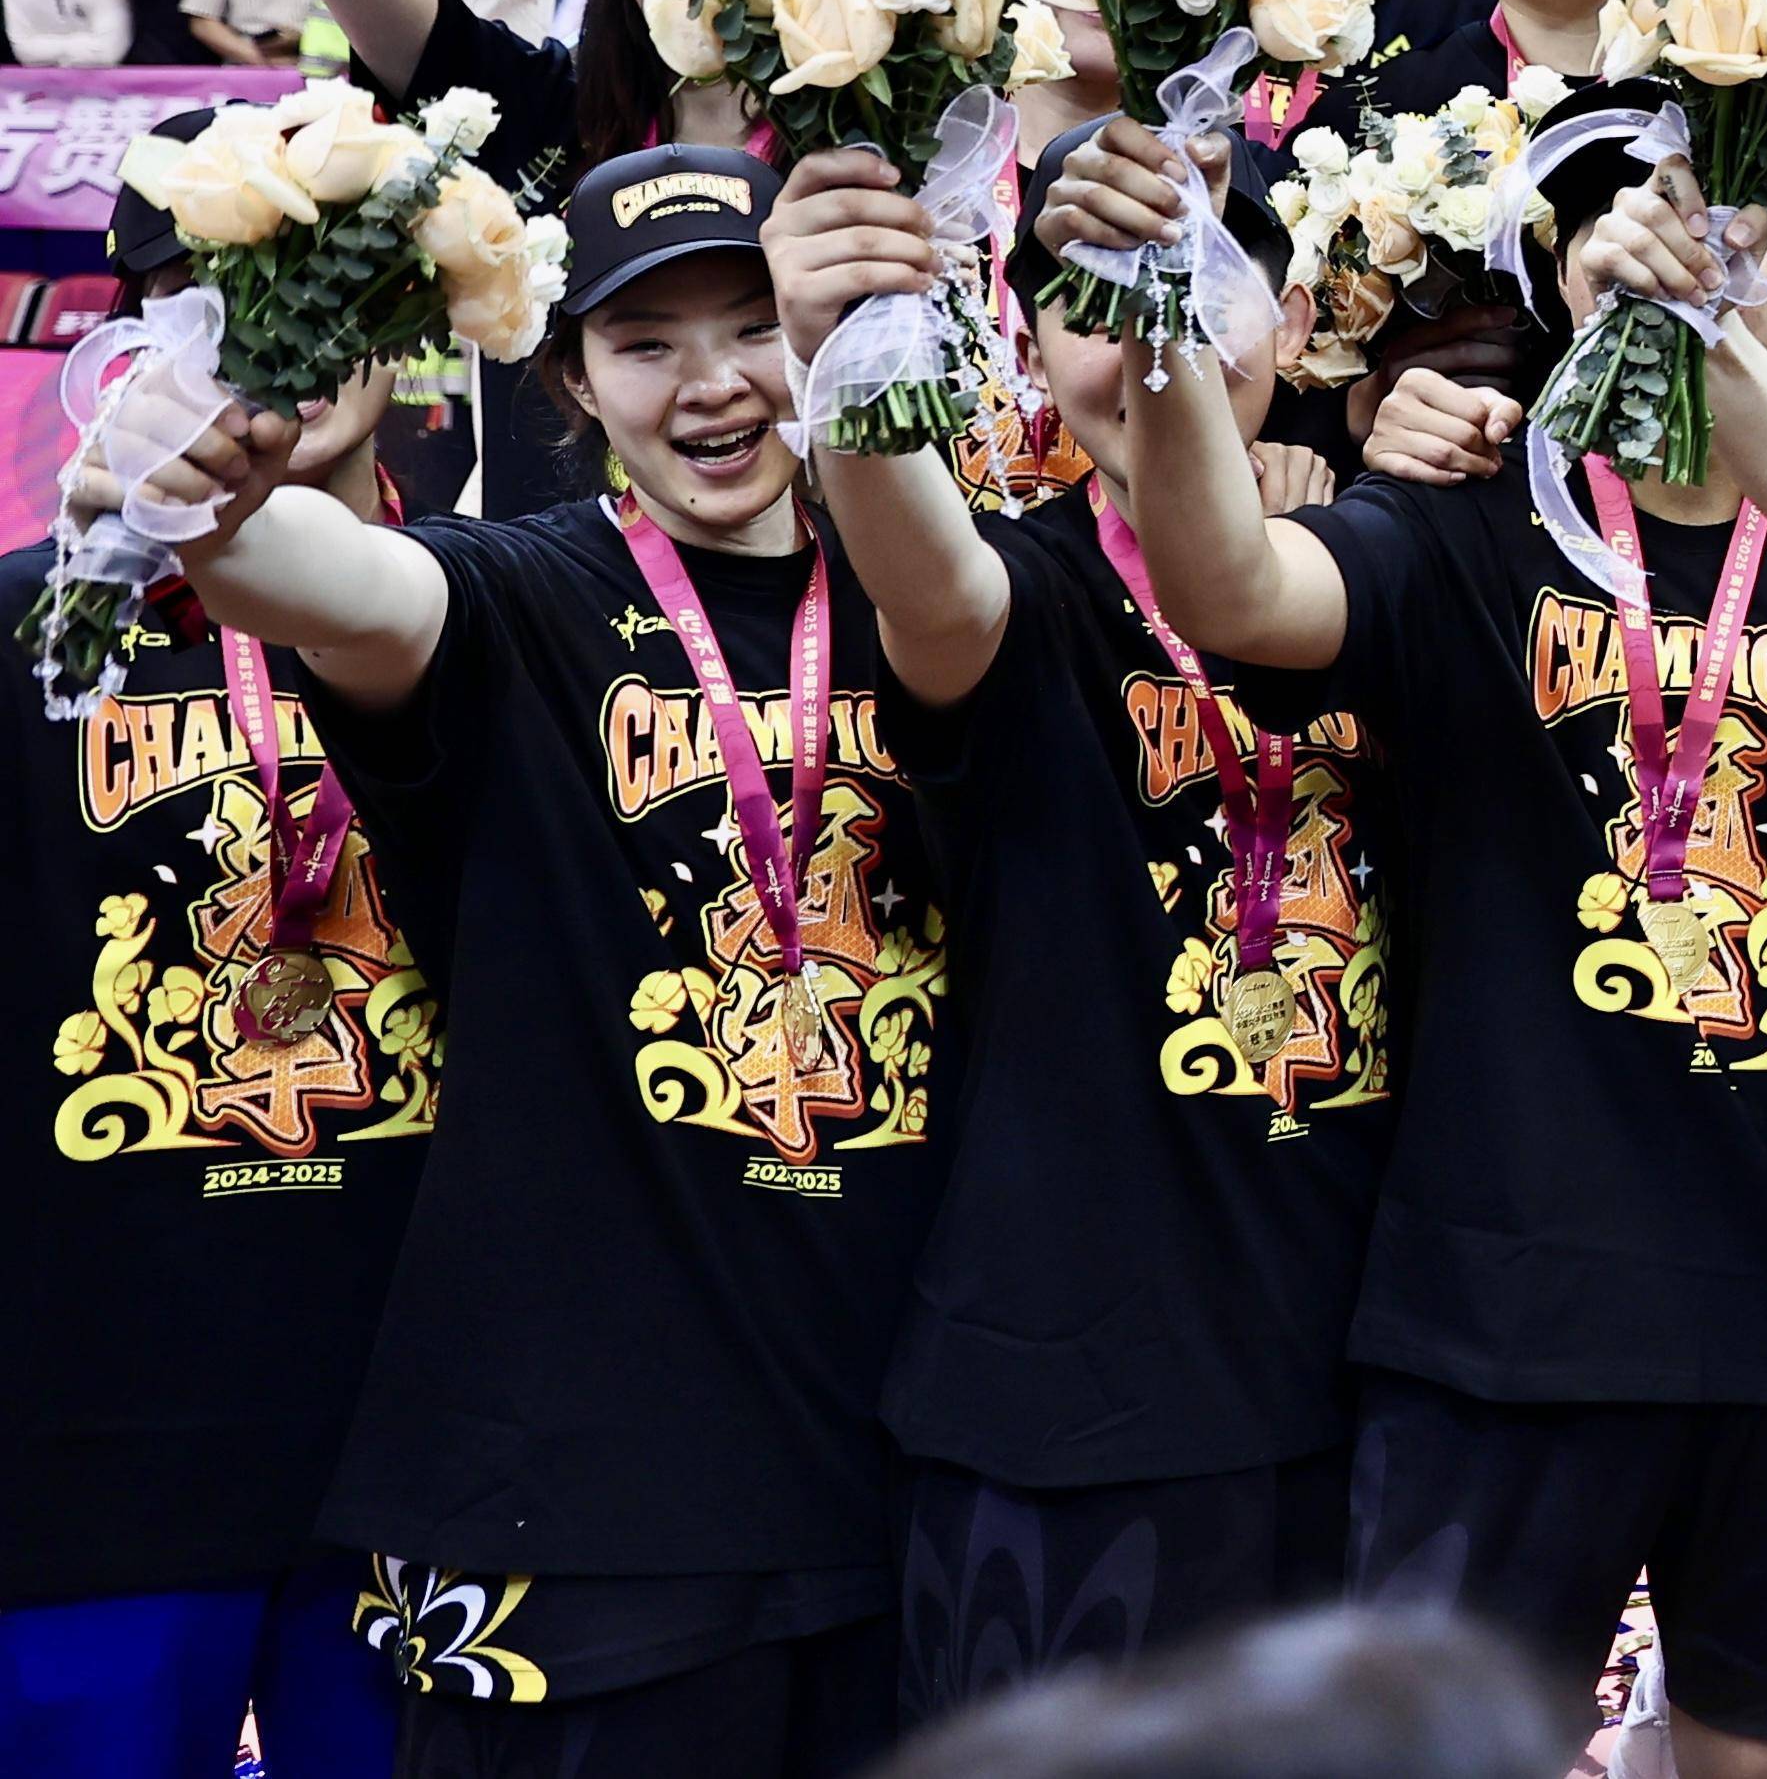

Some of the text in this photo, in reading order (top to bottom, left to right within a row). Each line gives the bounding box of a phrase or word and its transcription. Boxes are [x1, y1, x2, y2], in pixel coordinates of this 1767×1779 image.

[612, 171, 753, 230] CHAMPIONS
[648, 201, 721, 221] 2024-2025
[676, 607, 735, 706] 心不可挡
[204, 1162, 343, 1191] 2024-2025
